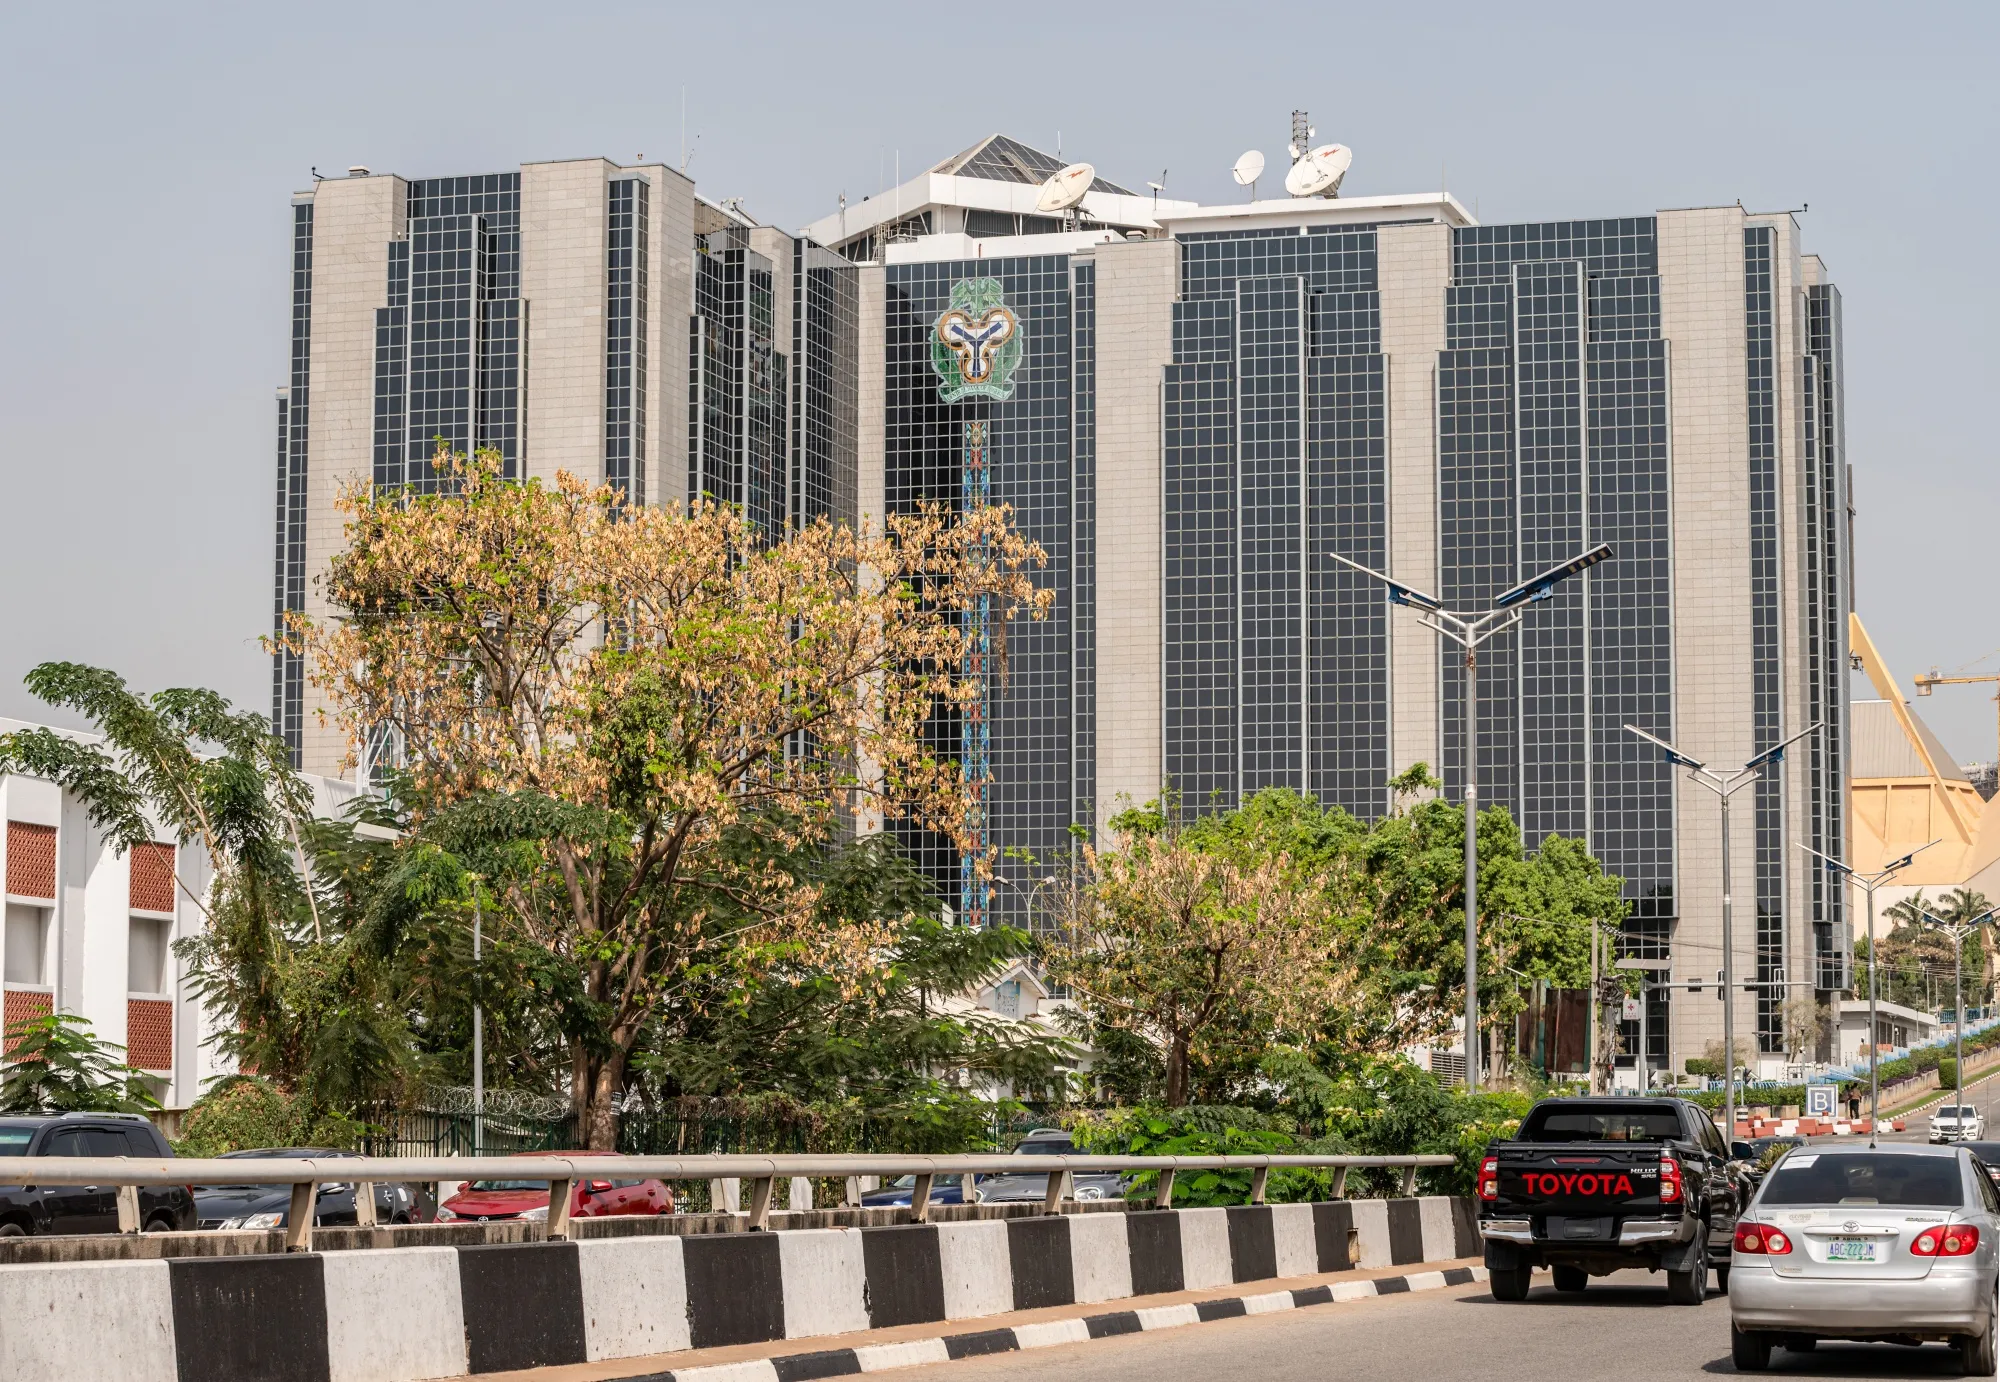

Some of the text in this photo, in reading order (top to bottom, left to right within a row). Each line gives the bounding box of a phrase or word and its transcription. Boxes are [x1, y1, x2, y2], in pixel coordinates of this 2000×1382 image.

[1814, 1092, 1828, 1111] B
[1522, 1173, 1634, 1195] TOYOTA
[1829, 1243, 1874, 1256] ABC-222JM
